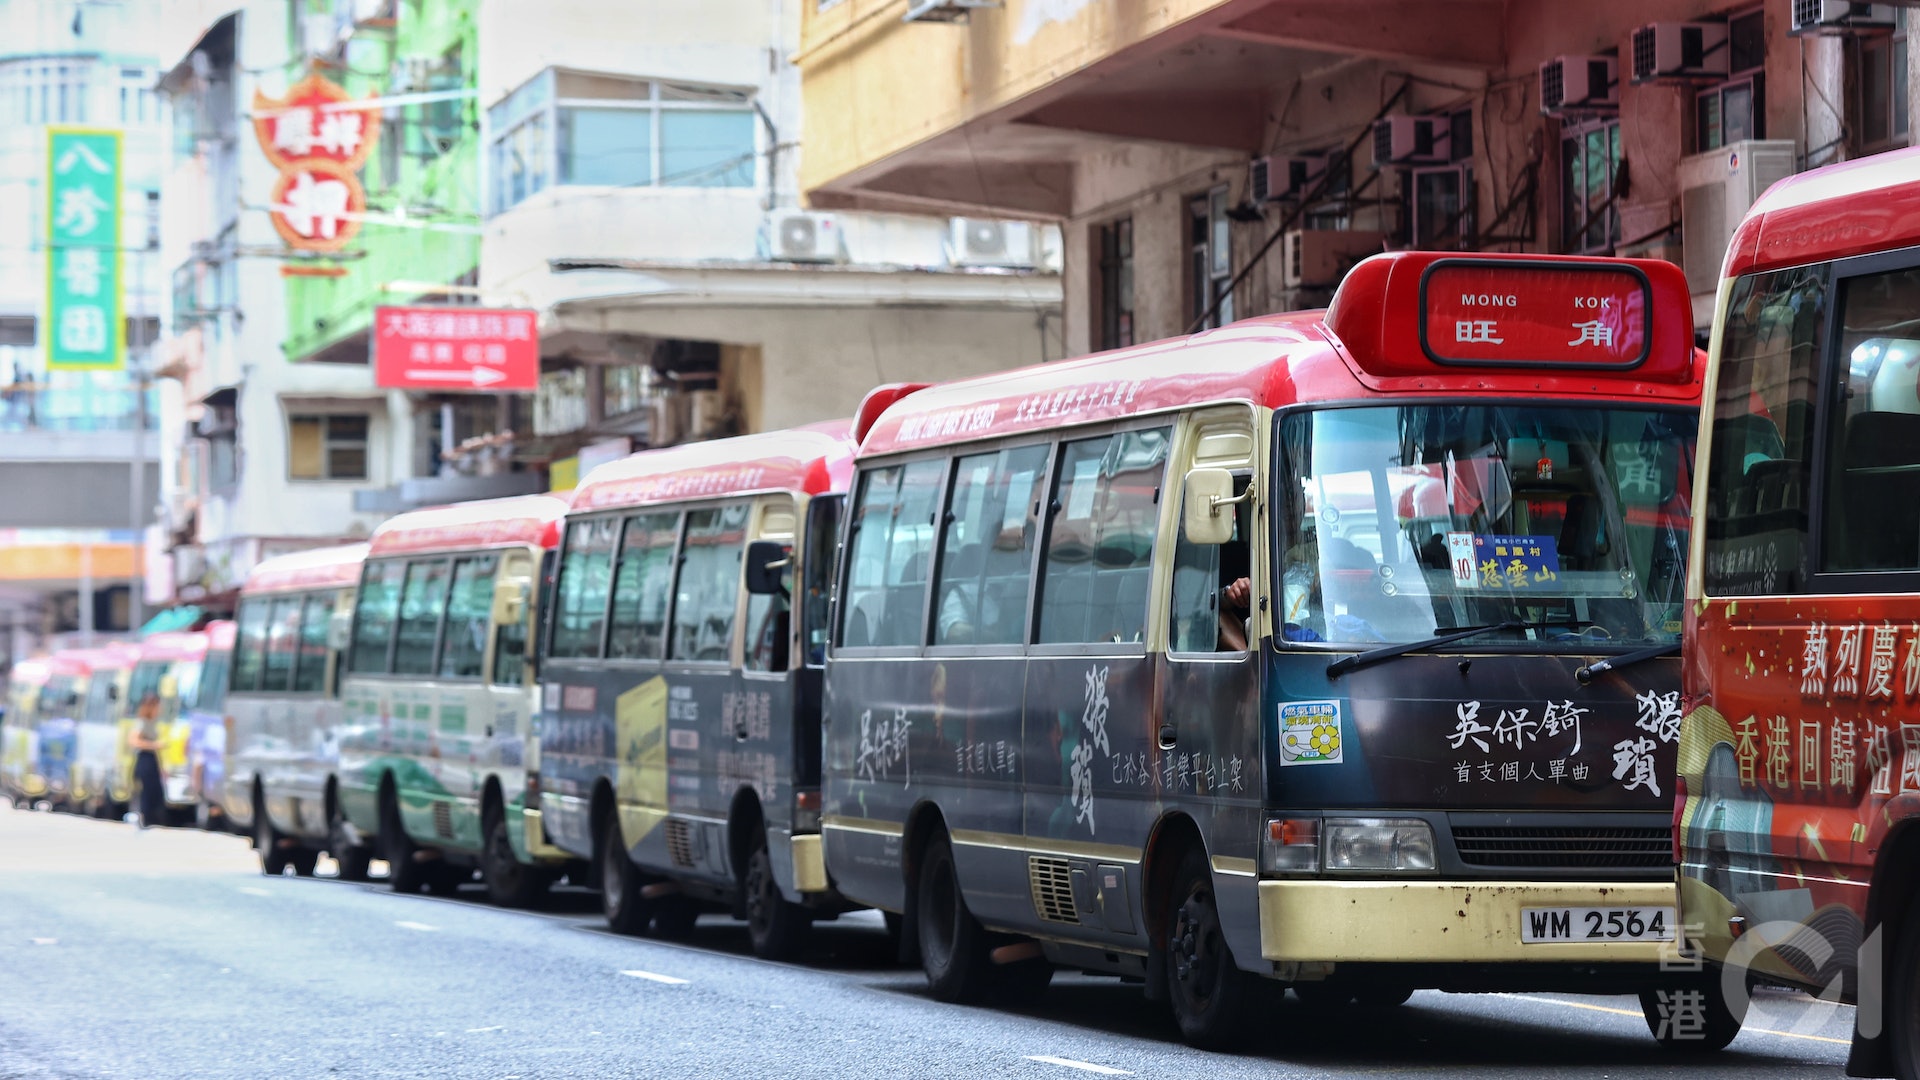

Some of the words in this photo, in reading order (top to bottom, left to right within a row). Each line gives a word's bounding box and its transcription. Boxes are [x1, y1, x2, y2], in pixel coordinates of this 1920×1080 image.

[1461, 294, 1517, 307] MONG
[1574, 296, 1611, 309] KOK
[1495, 546, 1541, 557] 鳳凰村
[1479, 558, 1556, 588] 慈雲山
[1735, 714, 1920, 796] 香港回歸祖國
[1453, 757, 1589, 784] 首支個人單曲
[1530, 910, 1571, 938] WM
[1586, 910, 1666, 939] 2564
